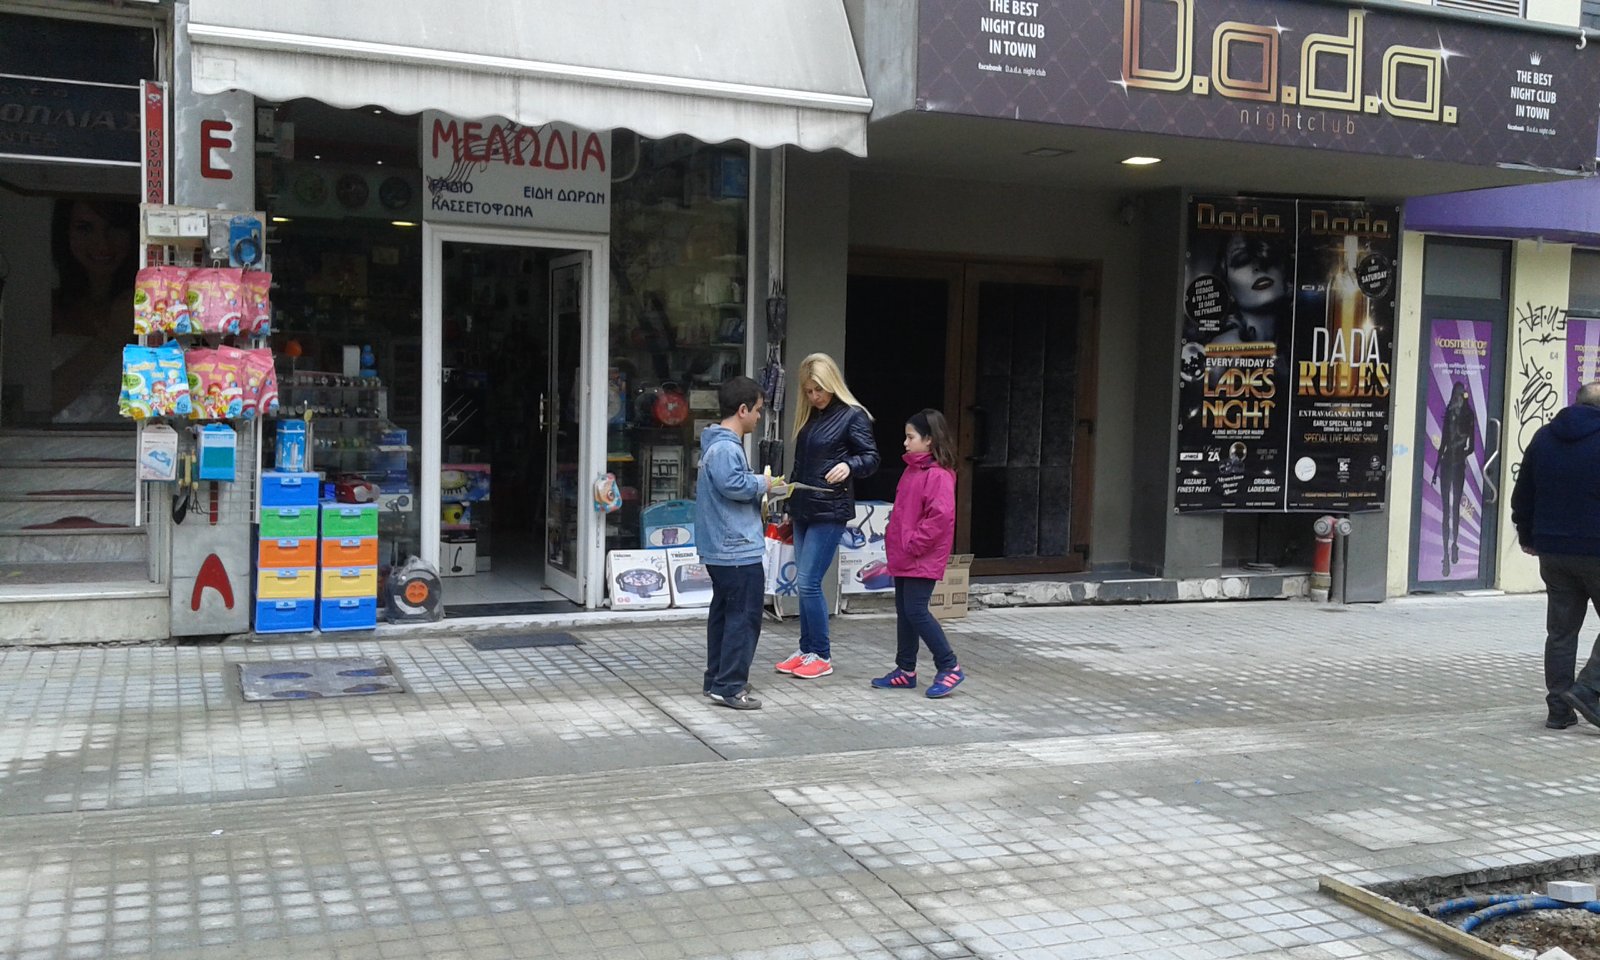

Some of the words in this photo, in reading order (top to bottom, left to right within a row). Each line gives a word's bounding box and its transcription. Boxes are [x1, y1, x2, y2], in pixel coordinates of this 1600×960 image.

[990, 0, 1010, 13] THE
[1012, 0, 1039, 17] BEST
[981, 17, 1016, 35] NIGHT
[1017, 22, 1045, 39] CLUB
[989, 39, 1002, 55] IN
[1003, 41, 1037, 59] TOWN
[978, 62, 1002, 72] facebook
[1023, 67, 1036, 76] night
[1036, 69, 1046, 77] club
[1516, 70, 1532, 83] THE
[1533, 73, 1553, 86] BEST
[1510, 86, 1536, 101] NIGHT
[1536, 90, 1557, 104] CLUB
[1240, 107, 1356, 135] nightclub
[1515, 104, 1525, 117] IN
[1526, 106, 1550, 120] TOWN
[432, 118, 606, 172] ΜΕΛΩΔΙΑ
[524, 186, 553, 200] ΕΙΔΗ
[557, 189, 605, 205] ΔΩΡΩΝ
[431, 199, 533, 217] ΚΑΣΣΕΤΟΦΩΝΑ
[1361, 271, 1387, 283] SATURDAY
[1312, 327, 1380, 367] DADA
[1206, 358, 1232, 367] EVERY
[1234, 358, 1265, 368] FRIDAY
[1267, 359, 1275, 368] IS
[1204, 368, 1276, 398] LADIES
[1297, 360, 1390, 398] RULES
[1202, 400, 1276, 429] NIGHT
[1367, 410, 1384, 418] MUSIC
[1304, 433, 1327, 442] SPECIAL
[1330, 433, 1343, 442] LIVE
[1344, 434, 1361, 442] MUSIC
[1363, 434, 1378, 442] SHOW
[1208, 452, 1220, 461] ZA
